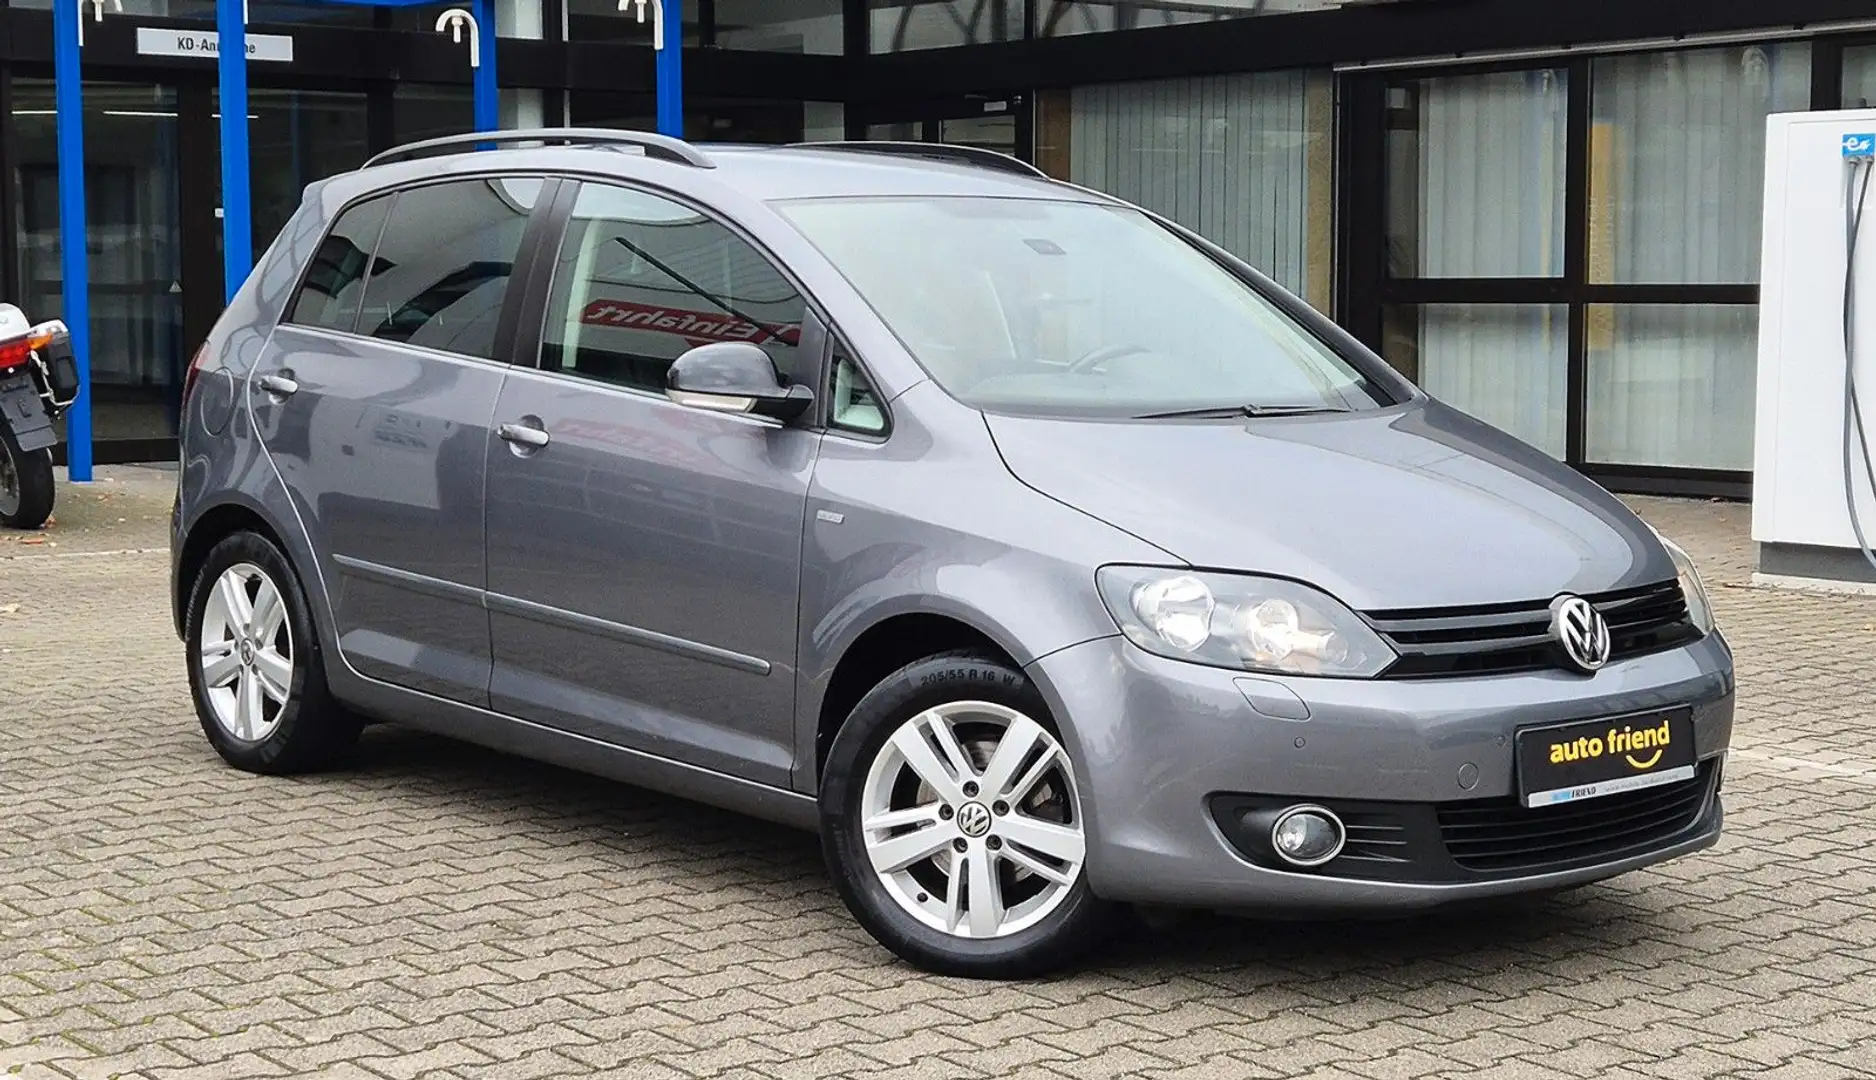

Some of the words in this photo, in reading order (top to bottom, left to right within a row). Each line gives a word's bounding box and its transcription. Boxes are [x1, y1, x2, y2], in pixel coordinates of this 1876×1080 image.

[177, 37, 256, 53] KD-Ane
[1559, 597, 1611, 670] VW
[920, 668, 965, 686] 205/55
[968, 669, 978, 680] R
[982, 670, 996, 681] 16
[1002, 673, 1017, 686] W
[1550, 736, 1603, 763] auto
[1607, 720, 1671, 754] friend
[1571, 786, 1597, 798] FRIEND
